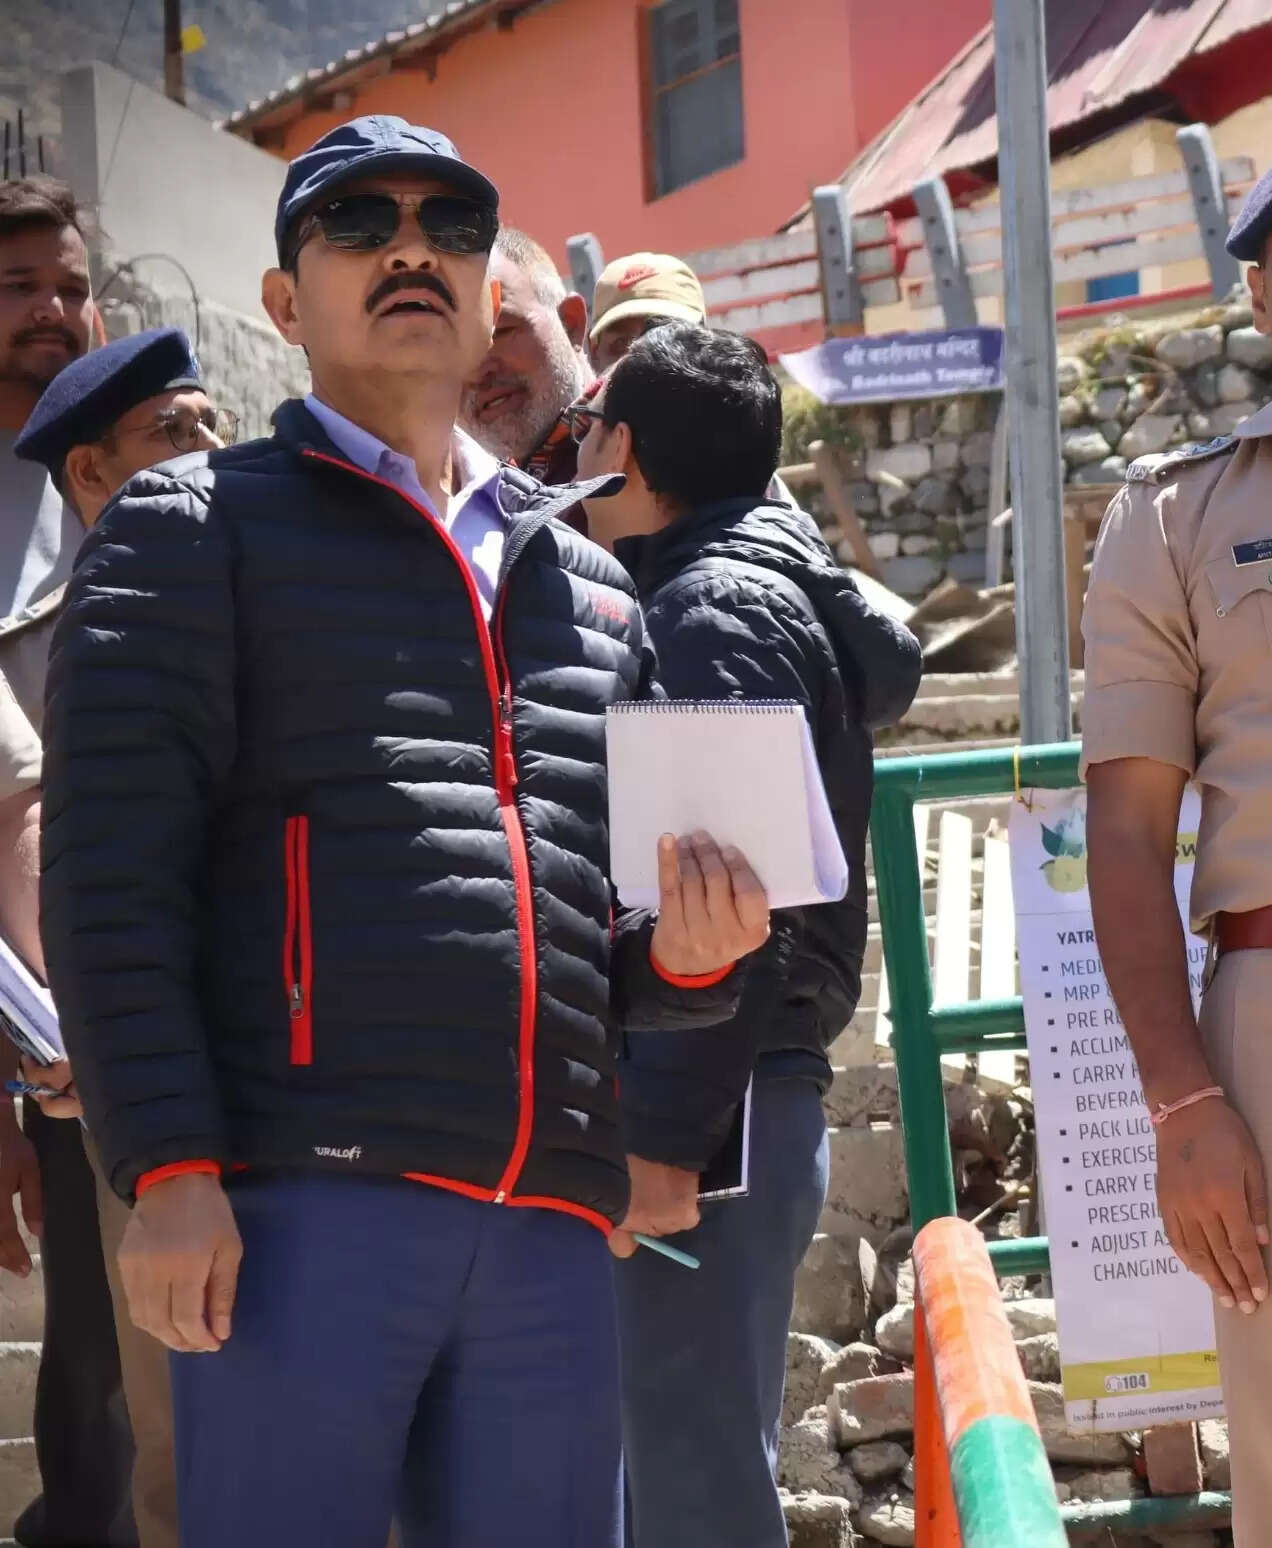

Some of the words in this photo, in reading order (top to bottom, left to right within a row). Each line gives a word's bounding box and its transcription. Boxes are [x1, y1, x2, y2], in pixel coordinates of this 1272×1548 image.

[1057, 930, 1095, 946] YATR
[1061, 959, 1101, 977] MEDI
[1064, 983, 1100, 1002] MRP
[1067, 1010, 1098, 1030] PRE
[1071, 1035, 1129, 1057] ACCLIM
[1073, 1063, 1125, 1085] CARRY
[1080, 1119, 1121, 1140] PACK
[1082, 1144, 1156, 1169] EXERCISE
[1085, 1175, 1138, 1197] CARRY
[1091, 1230, 1147, 1255] ADJUST
[1094, 1256, 1179, 1281] CHANGING
[1122, 1374, 1147, 1390] 104
[1149, 1403, 1184, 1414] interest
[1186, 1401, 1198, 1411] by
